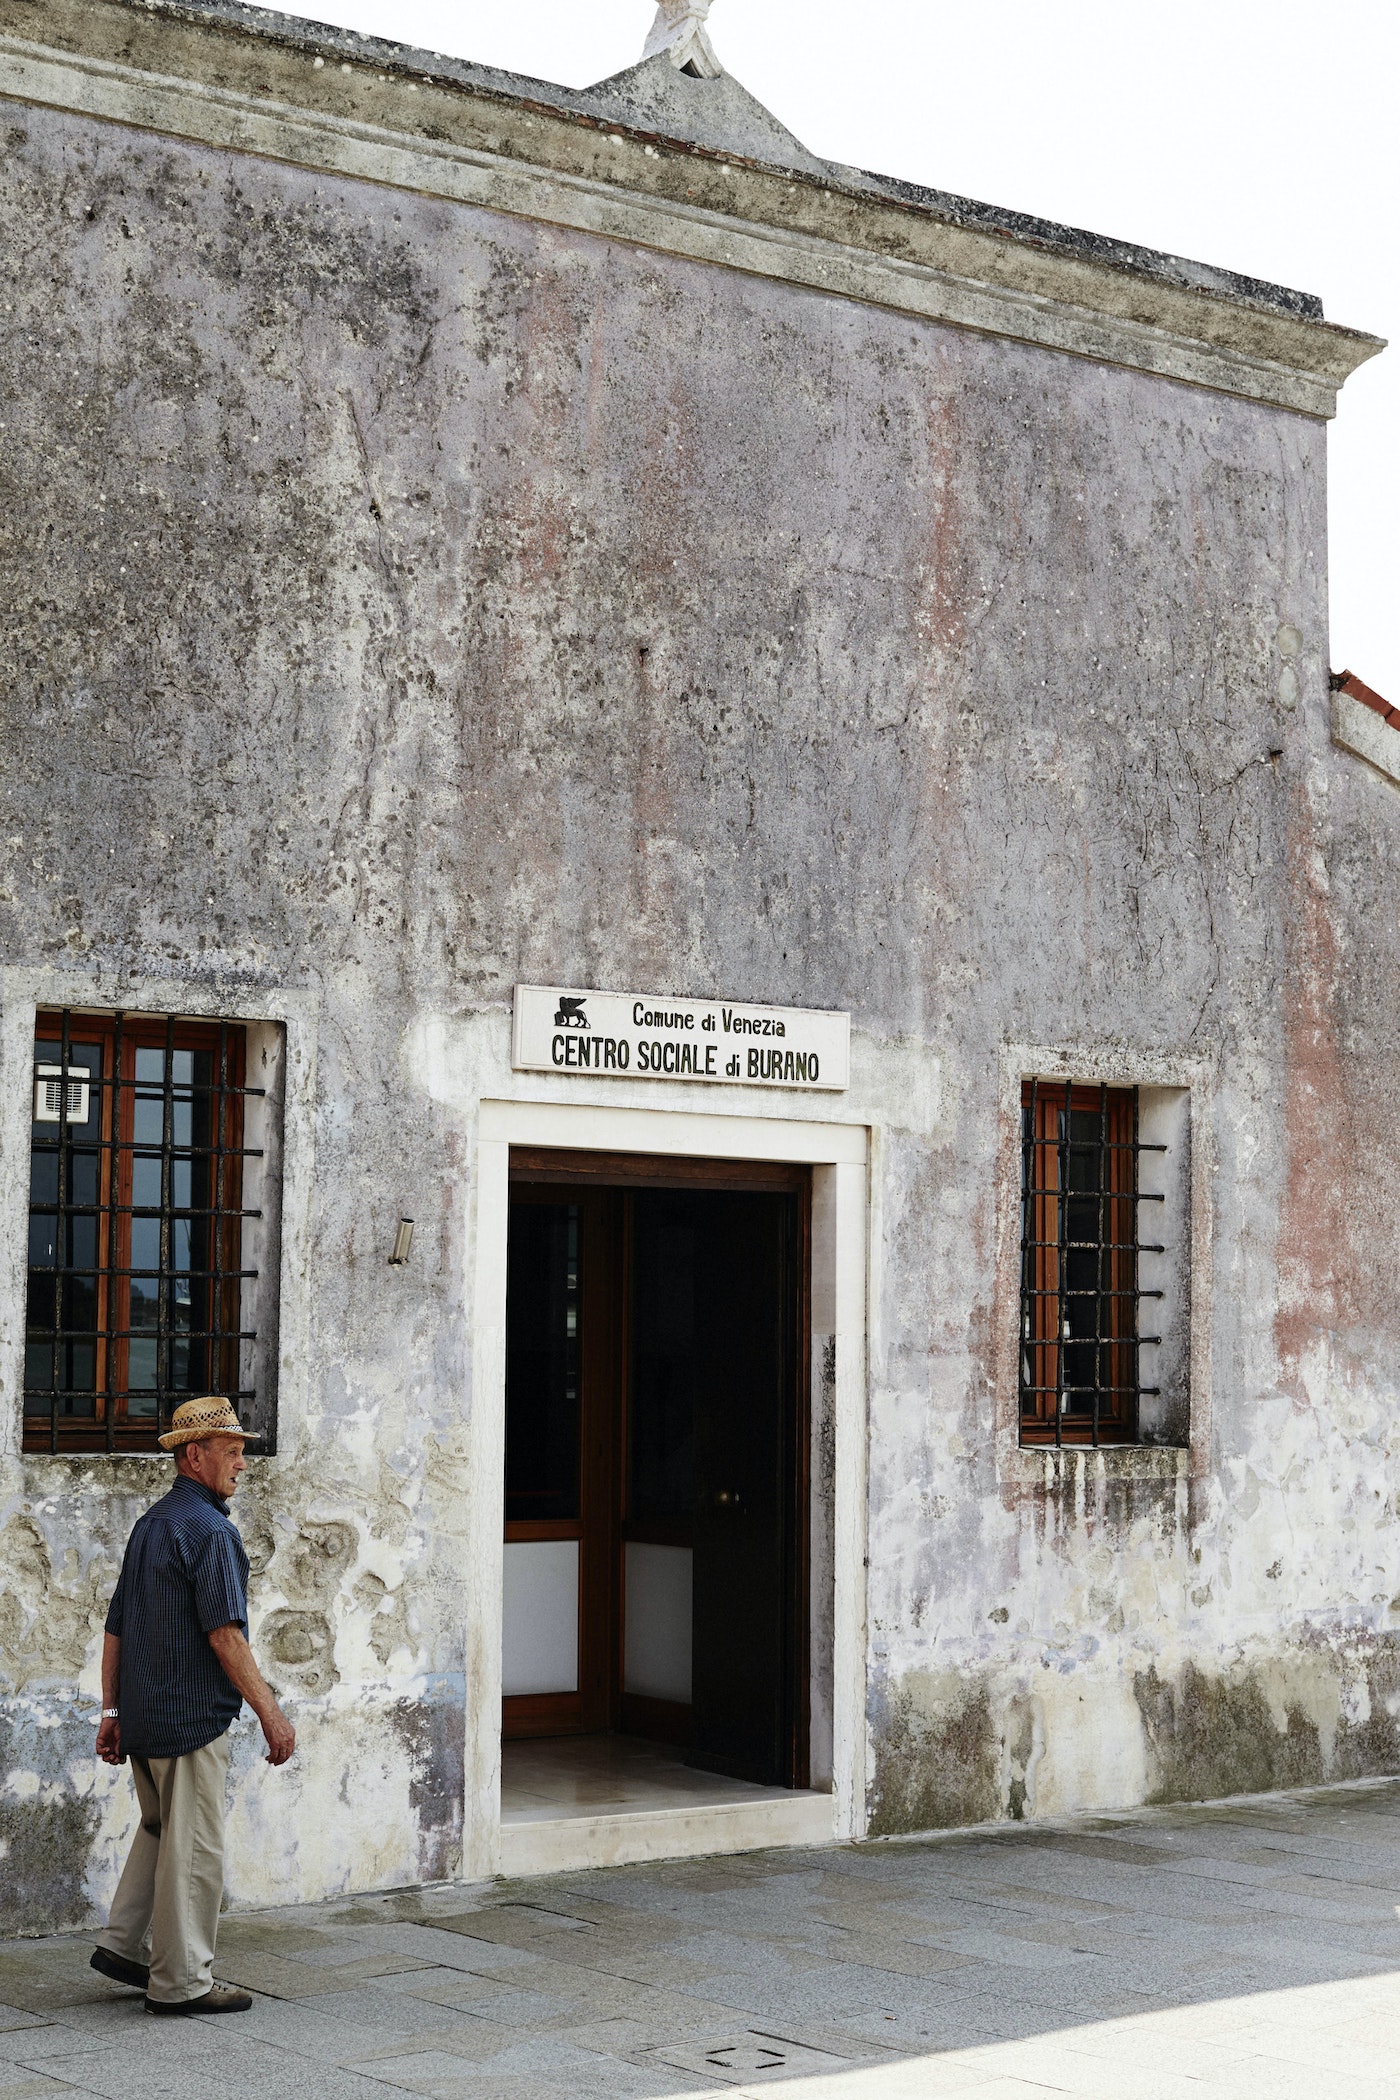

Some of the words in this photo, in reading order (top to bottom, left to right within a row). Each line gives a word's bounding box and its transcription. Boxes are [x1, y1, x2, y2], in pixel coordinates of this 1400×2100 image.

[632, 1001, 695, 1030] Comune
[701, 1013, 716, 1032] di
[722, 1008, 786, 1038] Venezia
[552, 1035, 630, 1070] CENTRO
[637, 1041, 718, 1076] SOCIALE
[725, 1053, 741, 1077] di
[748, 1048, 820, 1082] BURANO
